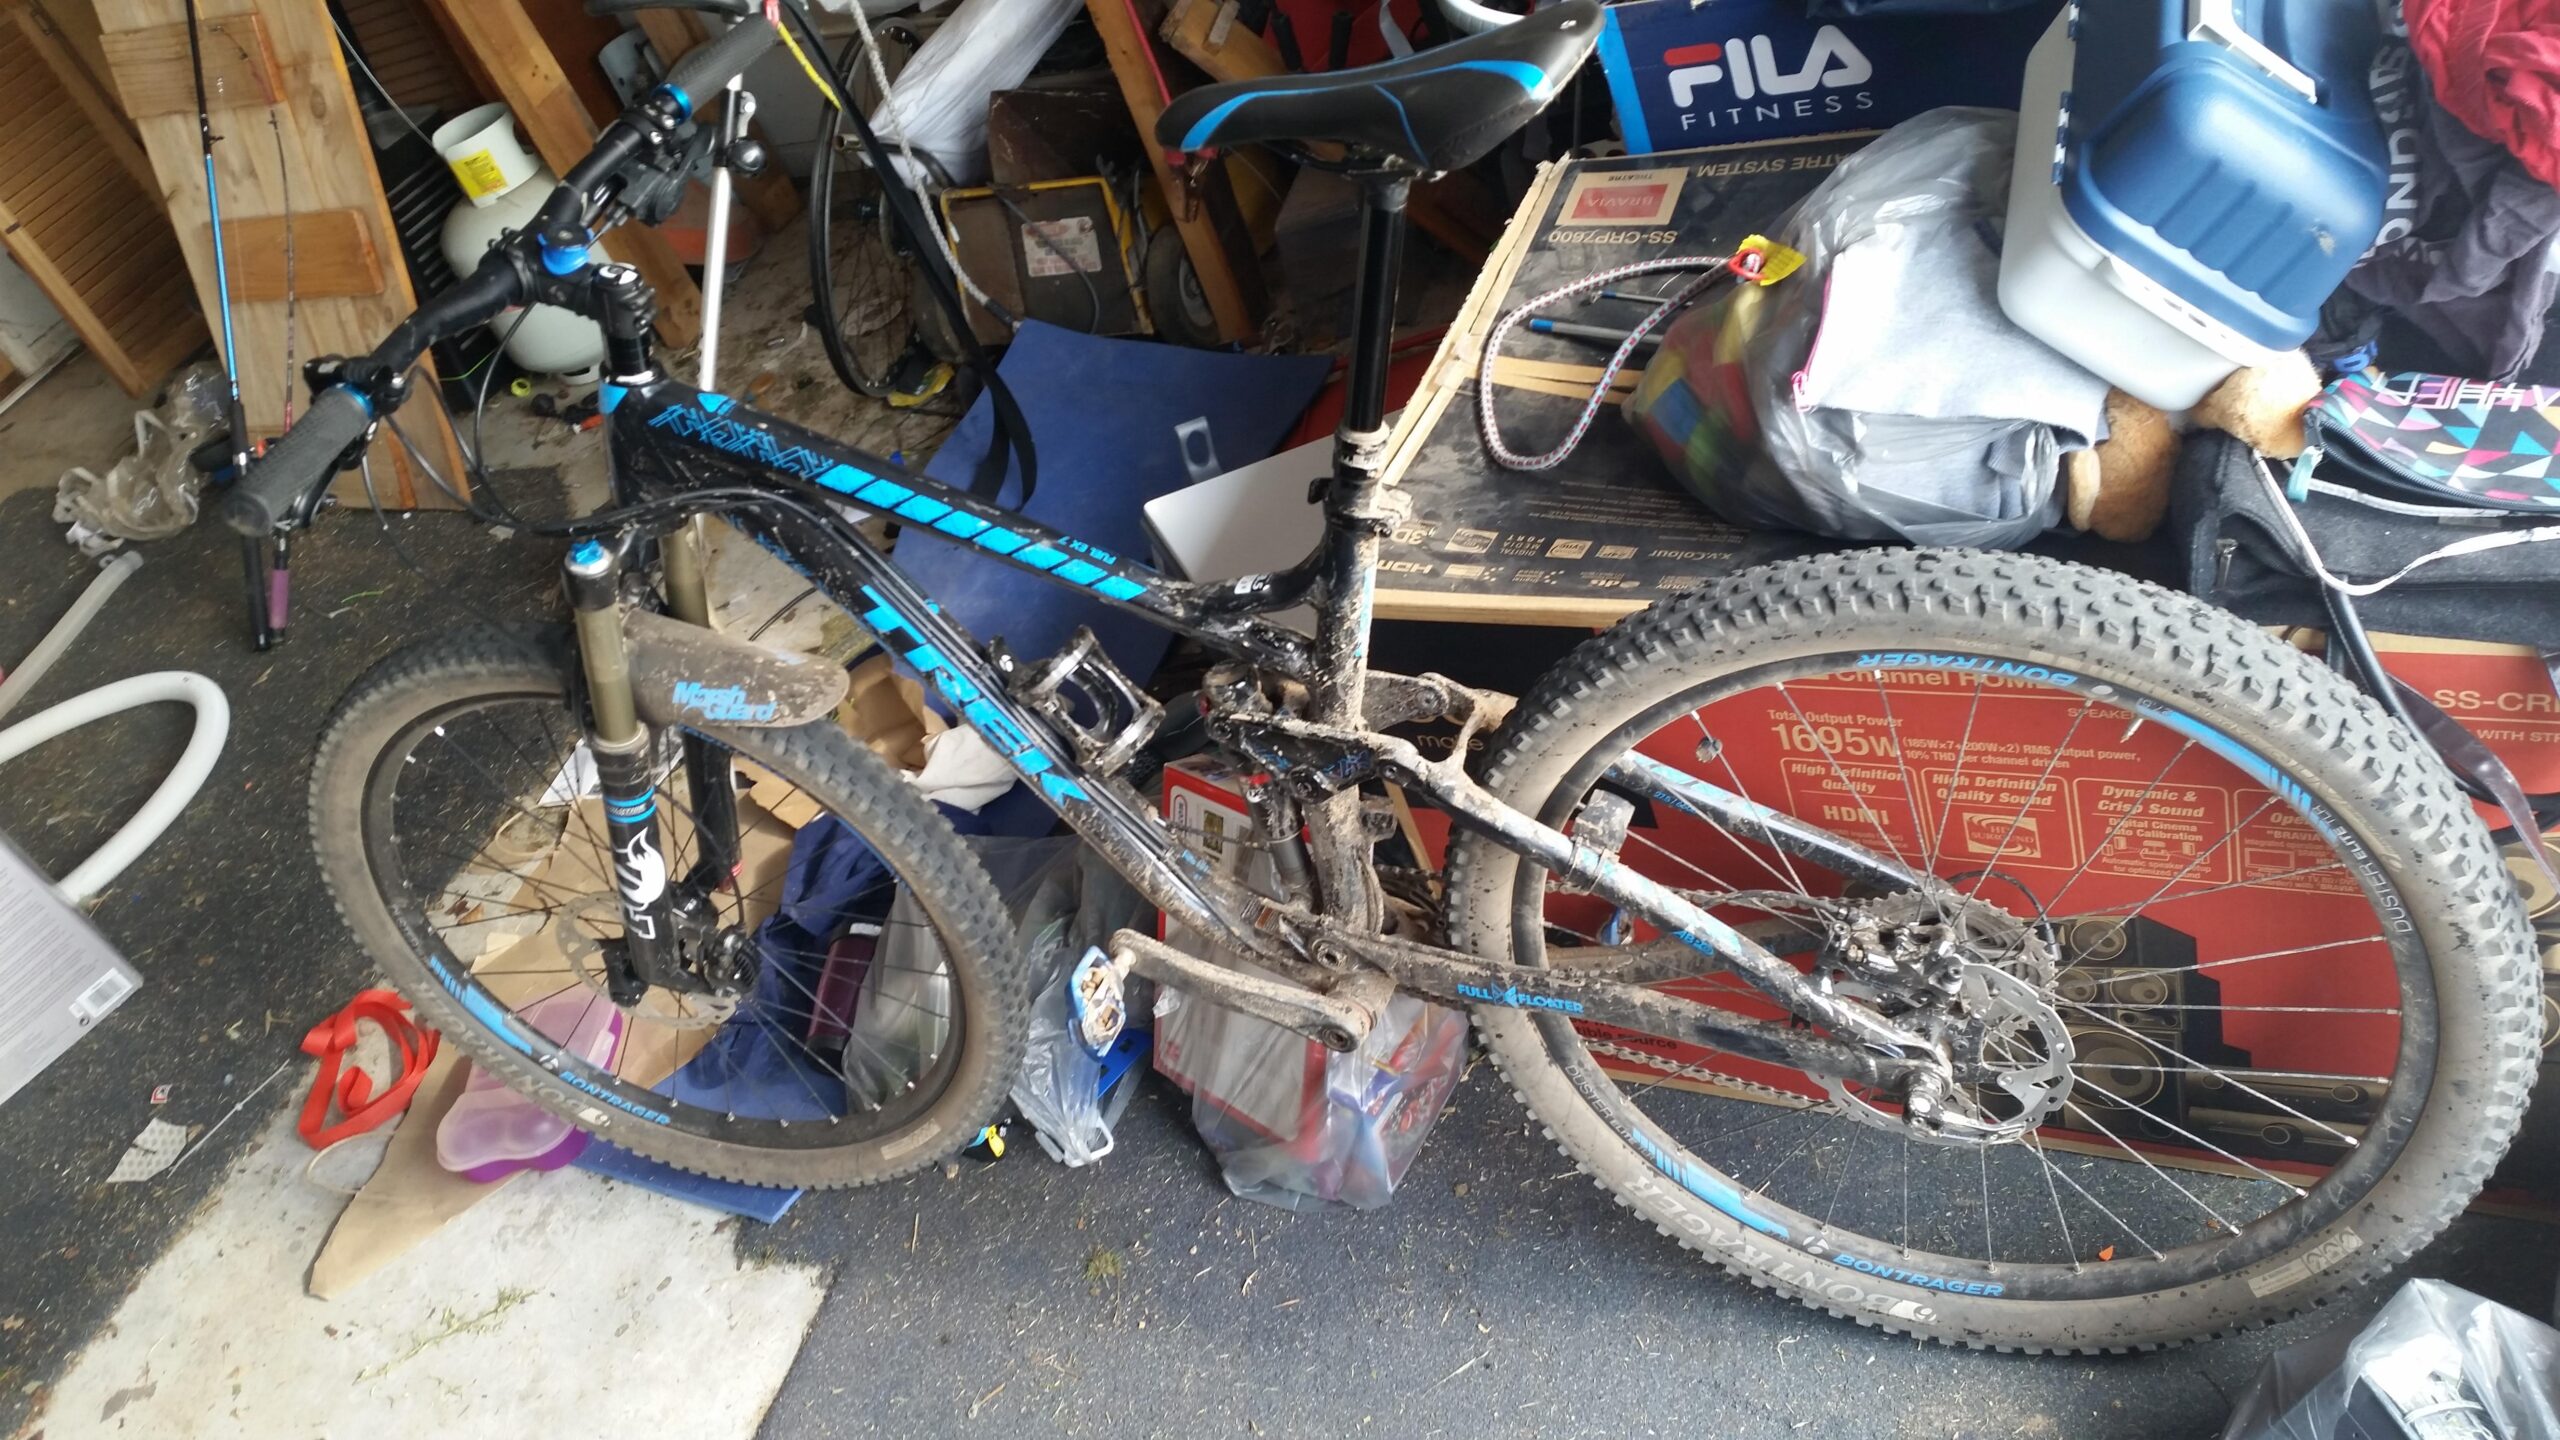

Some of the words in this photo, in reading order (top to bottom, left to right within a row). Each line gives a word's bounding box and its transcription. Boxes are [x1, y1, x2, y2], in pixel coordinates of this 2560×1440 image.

[1664, 24, 1873, 108] FILA
[1681, 91, 1874, 131] FITNESS
[1697, 159, 1784, 178] SYSTEM
[1587, 195, 1655, 208] BRAVIA
[1069, 539, 1089, 553] EX
[1503, 542, 1541, 550] MEDIA
[1507, 534, 1546, 543] PORT
[1089, 546, 1118, 566] FUEL
[1500, 549, 1537, 557] DIGITAL
[1648, 549, 1733, 560] x.v.Colour
[1856, 652, 2079, 688] BONTRAGER
[1805, 711, 1853, 725] Output
[2067, 707, 2135, 720] SPEAKE
[2477, 729, 2525, 741] WITH
[1905, 750, 1929, 760] 10%
[1933, 752, 1955, 762] THD
[1981, 755, 2029, 767] channel
[2023, 744, 2051, 755] RMS
[2054, 747, 2095, 761] utput
[1791, 763, 1825, 776] High
[1932, 773, 1969, 788] High
[1975, 776, 2057, 792] Definition
[1936, 788, 1994, 803] Quality
[1999, 792, 2053, 806] Sound
[2102, 785, 2178, 801] Dynamic
[2183, 791, 2197, 802] &
[2097, 800, 2143, 815] Crisp
[2149, 803, 2205, 817] Sound
[2152, 821, 2197, 832] Cinema
[2136, 829, 2203, 842] Calibration
[2333, 826, 2367, 860] ELITE
[2360, 863, 2412, 933] DUSTER
[1457, 983, 1492, 1000] FULL
[1517, 993, 1584, 1014] FLOATER
[1565, 1065, 1614, 1120] DUSTER
[1832, 1252, 2005, 1298] BONTRAGER
